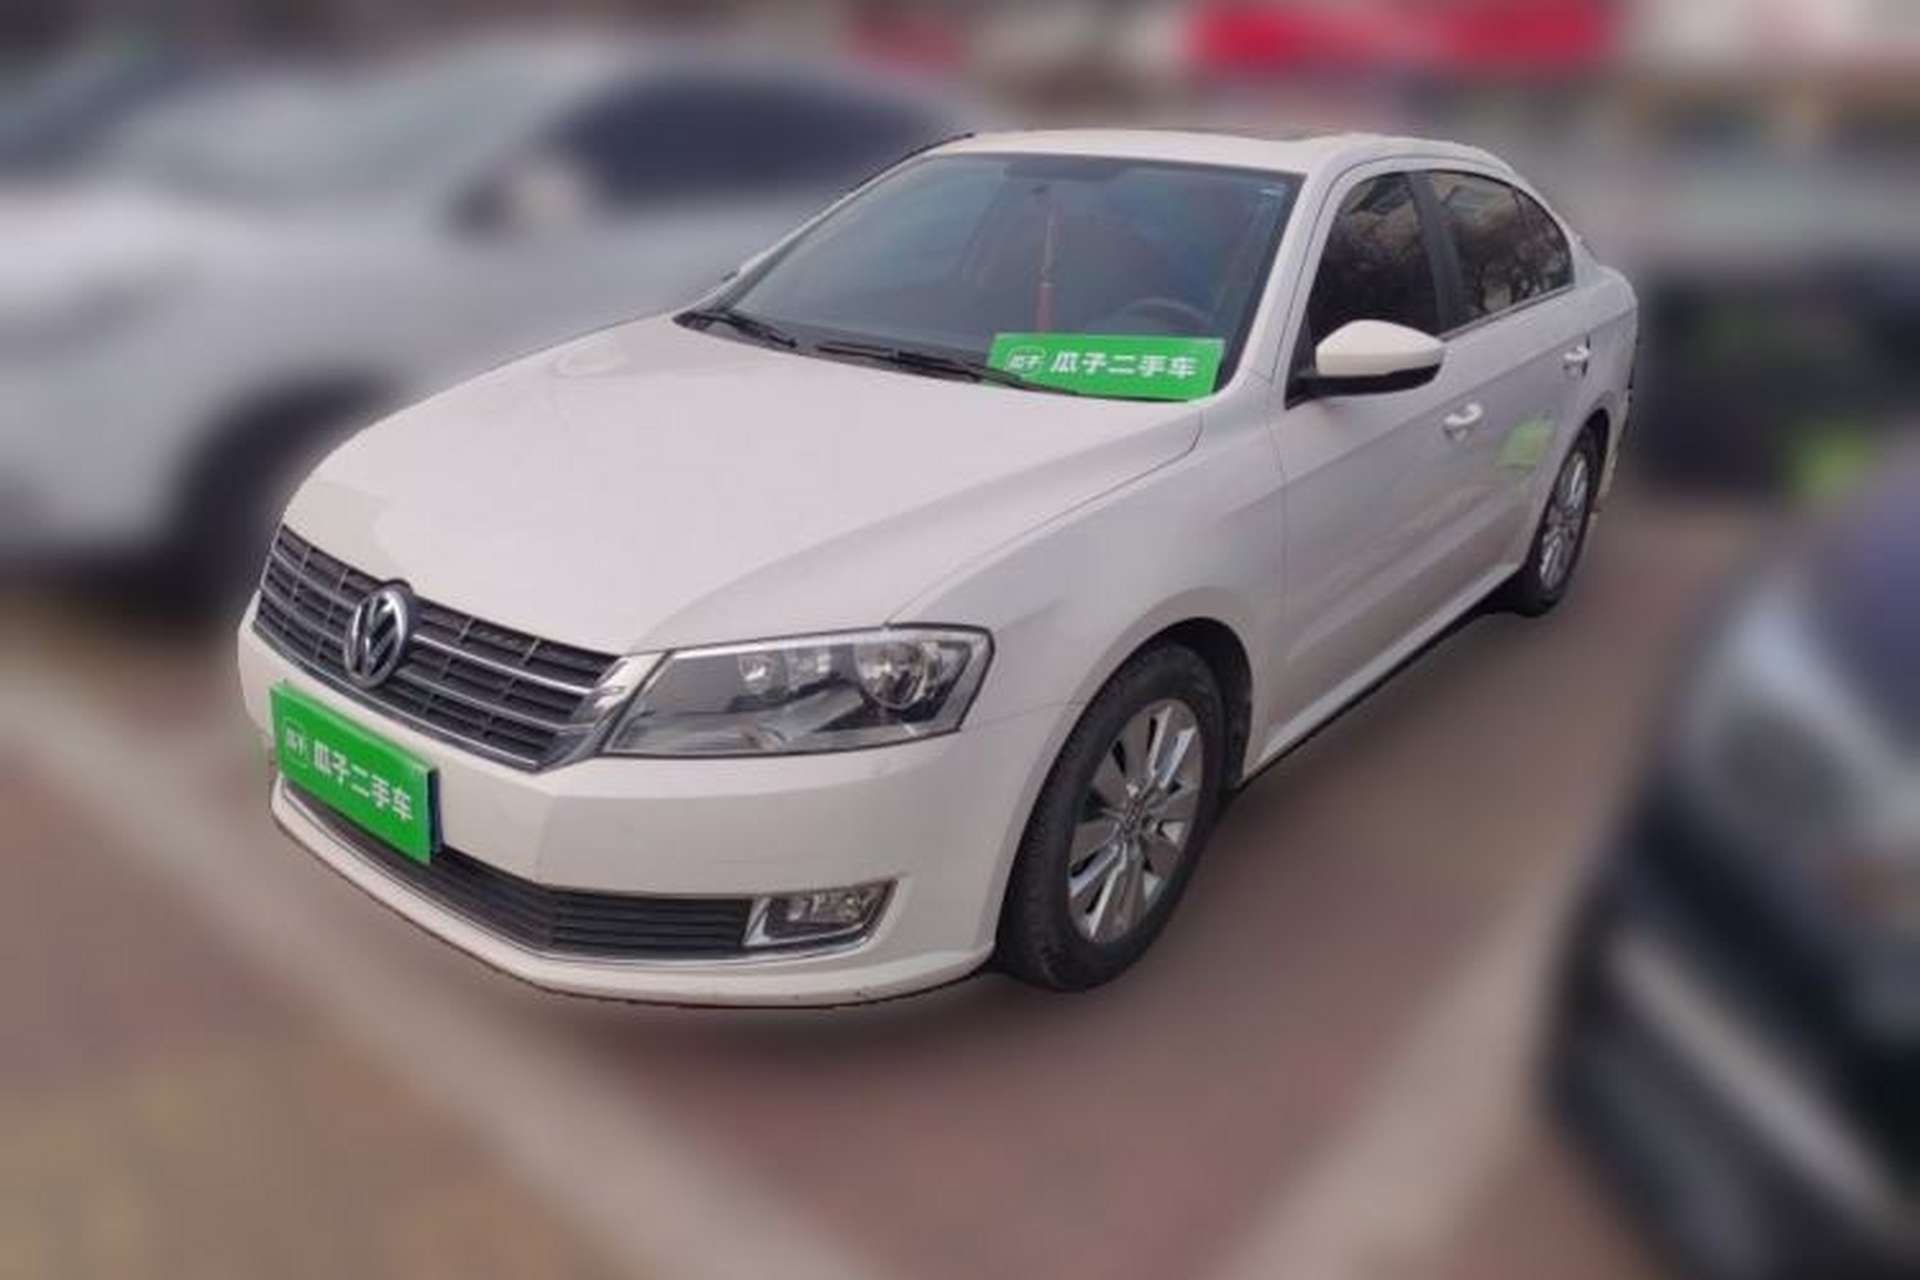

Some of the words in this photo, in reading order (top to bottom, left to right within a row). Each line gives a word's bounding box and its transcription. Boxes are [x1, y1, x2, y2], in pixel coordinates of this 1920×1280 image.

[1050, 350, 1197, 378] 瓜子二手车
[313, 740, 413, 821] 瓜子二手车
